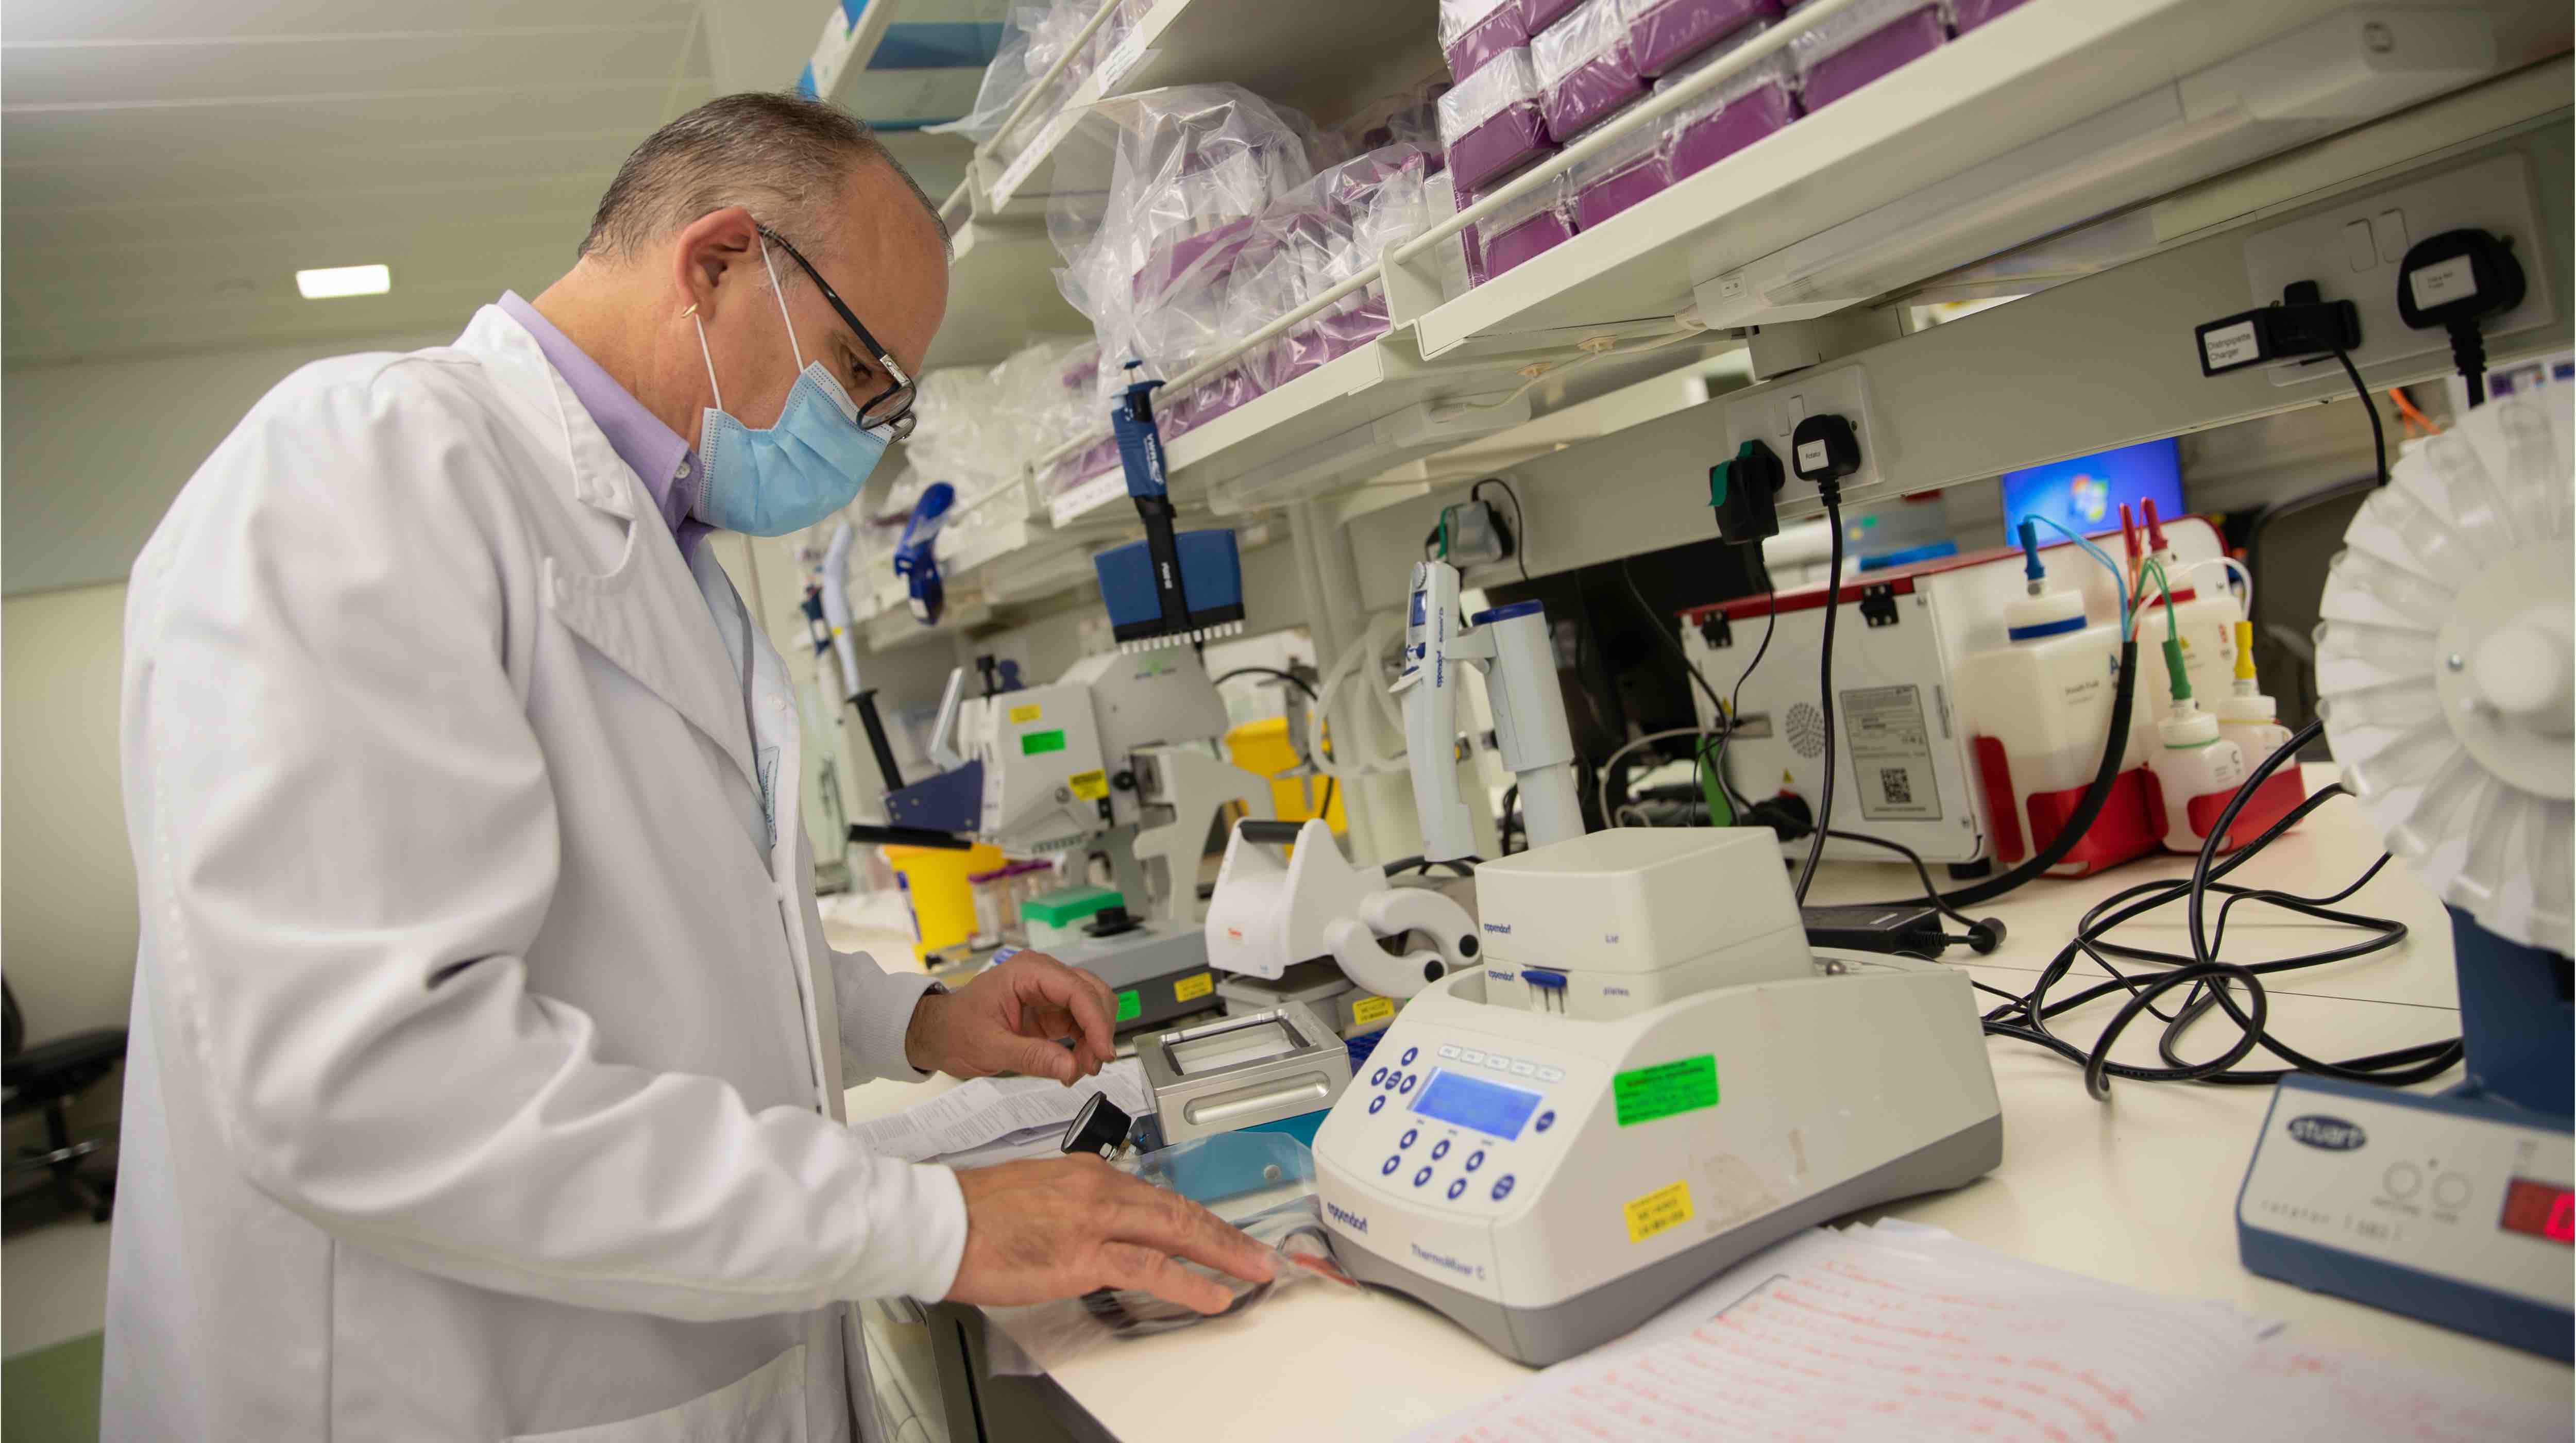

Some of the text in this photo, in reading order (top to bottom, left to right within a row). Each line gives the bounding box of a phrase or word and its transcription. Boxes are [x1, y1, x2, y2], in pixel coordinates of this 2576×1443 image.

[2209, 348, 2239, 362] Charger
[1484, 923, 1511, 934] eppendorf
[1488, 969, 1515, 982] eppendorf
[1327, 1202, 1368, 1233] eppendorf
